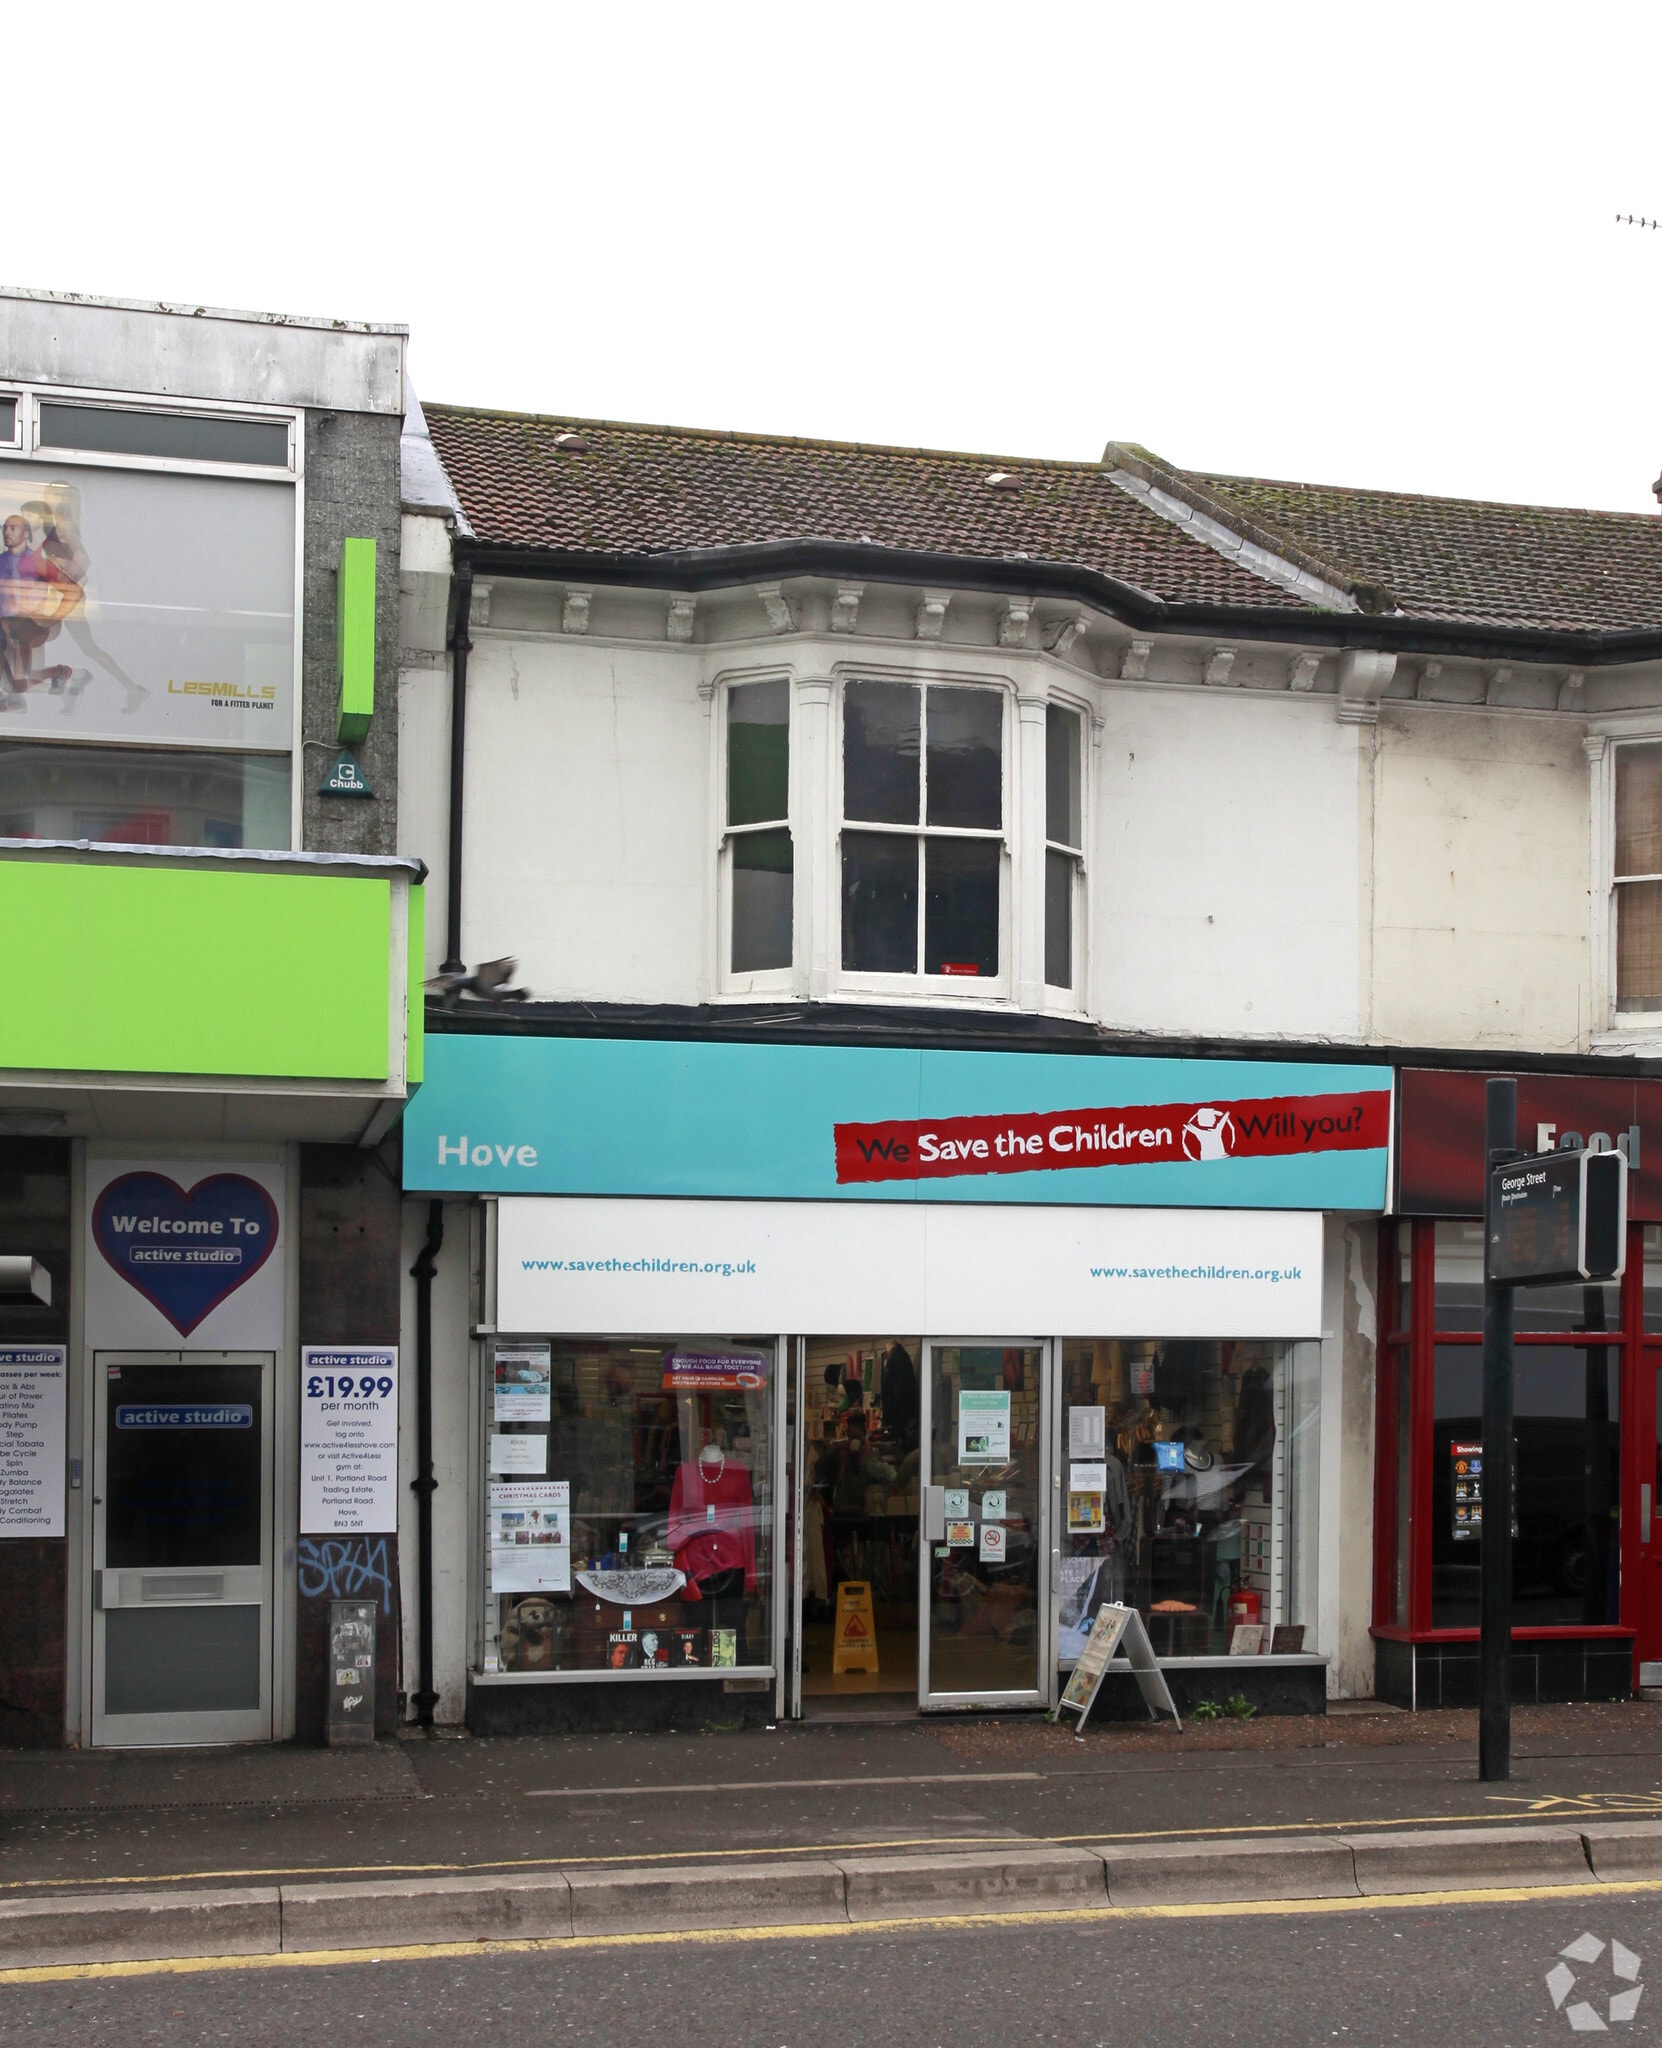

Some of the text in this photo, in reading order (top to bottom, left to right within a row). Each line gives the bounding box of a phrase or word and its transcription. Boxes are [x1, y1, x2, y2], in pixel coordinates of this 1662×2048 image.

[211, 699, 223, 707] FOR
[230, 700, 250, 709] FITTER
[252, 702, 274, 710] PLANET
[330, 779, 363, 789] Chubb
[857, 1107, 1365, 1163] We Save the Children Will you?
[437, 1135, 538, 1168] Hove
[1502, 1171, 1546, 1191] George Street
[112, 1215, 260, 1235] Welcome To
[134, 1249, 235, 1262] active studio
[522, 1258, 756, 1277] www.savethechildren.org.uk
[1089, 1265, 1302, 1283] www.savethechildren.org.uk
[15, 1353, 55, 1362] studio
[311, 1355, 387, 1365] active studio
[307, 1376, 393, 1398] £19.99
[321, 1401, 379, 1412] per month
[123, 1410, 242, 1424] active studio
[335, 1431, 347, 1439] log
[13, 1450, 37, 1458] Cycle
[1456, 1446, 1483, 1454] Showing
[6, 1459, 23, 1467] Spin
[323, 1486, 350, 1494] Trading
[0, 1517, 51, 1525] Conditioning
[609, 1633, 638, 1643] KILLER
[712, 1630, 720, 1667] ROTTEN
